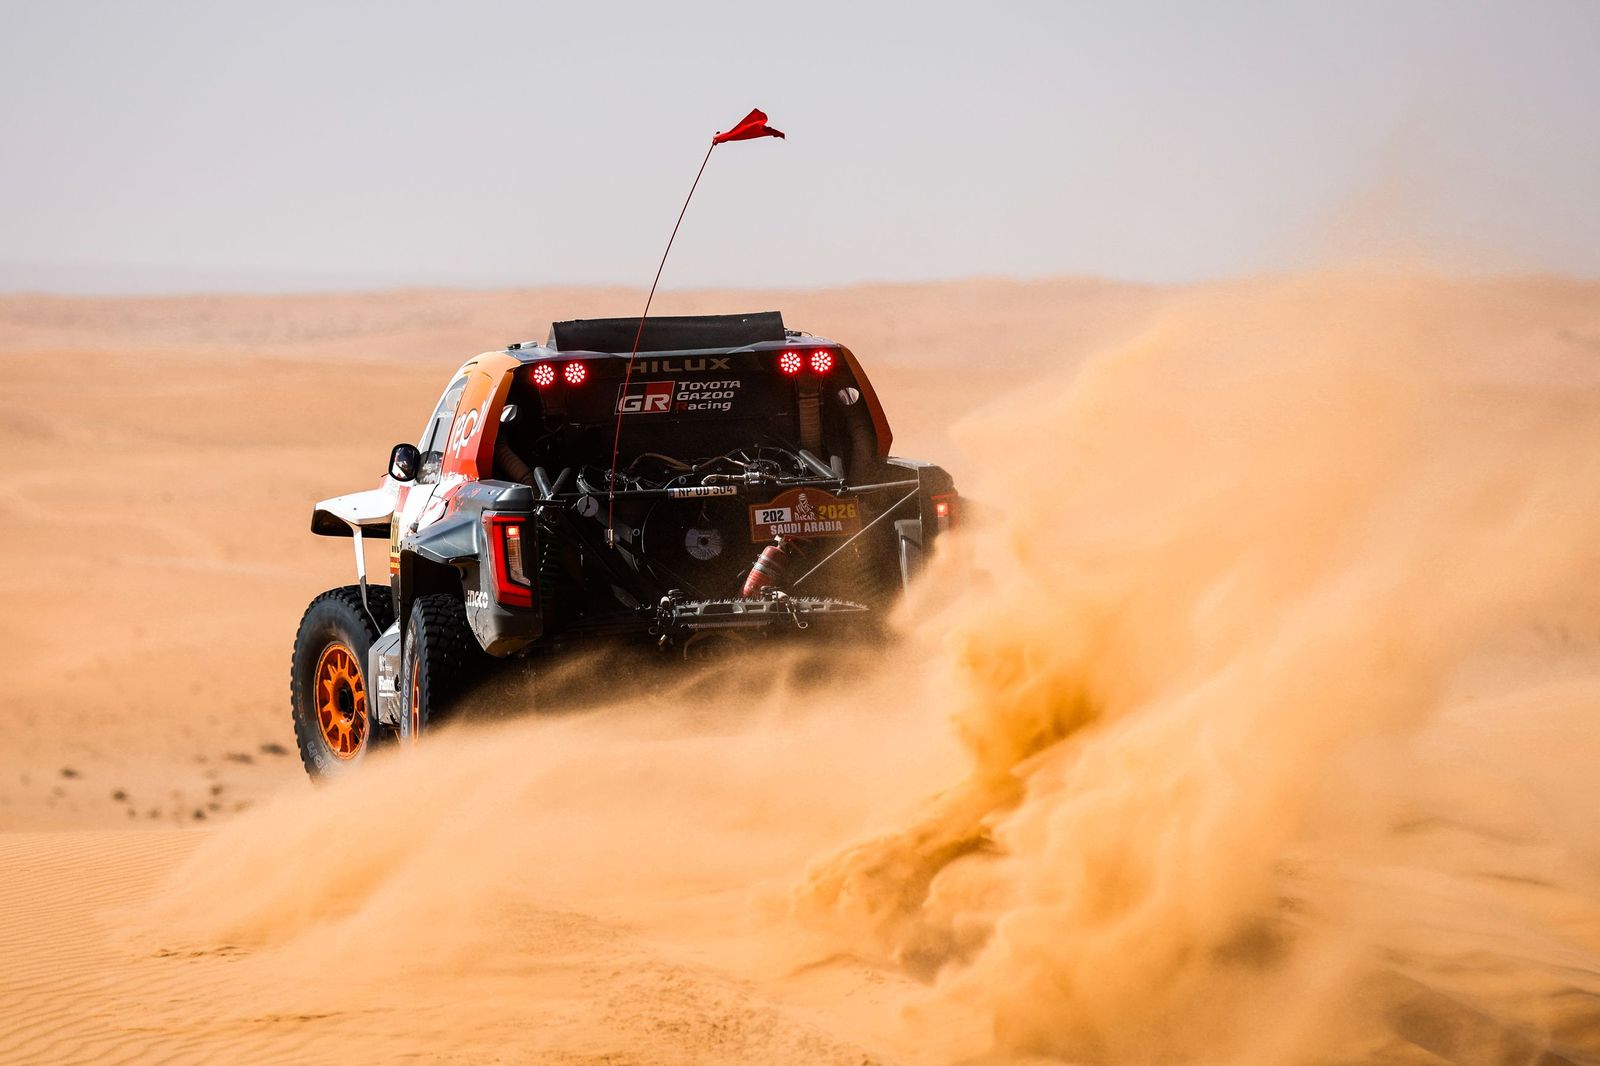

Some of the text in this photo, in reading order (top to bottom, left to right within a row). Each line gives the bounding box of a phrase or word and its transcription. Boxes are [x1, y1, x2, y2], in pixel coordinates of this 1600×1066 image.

[625, 358, 731, 374] HILUX
[677, 380, 741, 391] TOYOTA
[618, 393, 670, 412] GR
[676, 391, 735, 401] GAZOO
[675, 400, 732, 412] Racing
[762, 510, 785, 523] 202
[818, 503, 857, 520] 2026
[770, 520, 843, 536] SAUDI ARABIA
